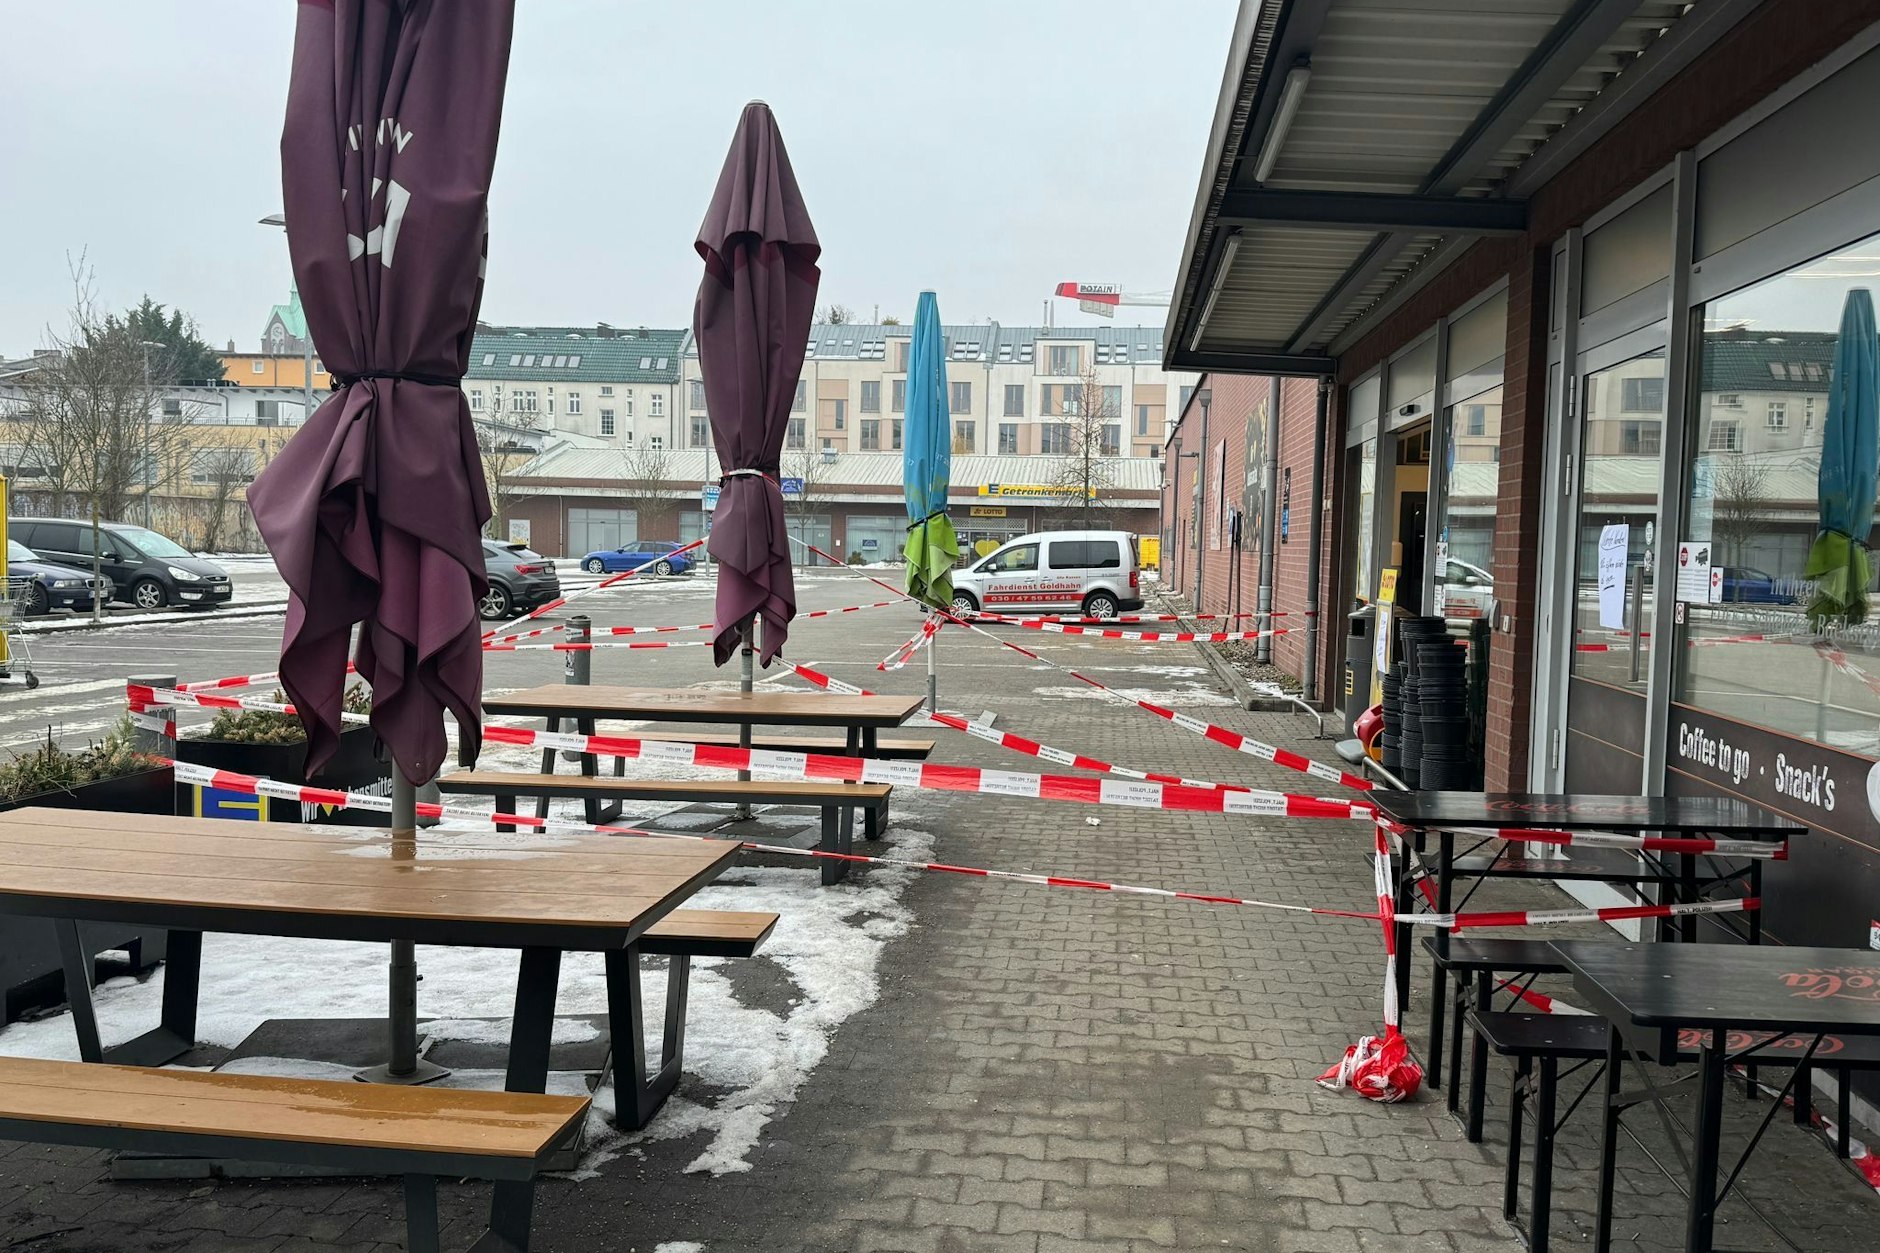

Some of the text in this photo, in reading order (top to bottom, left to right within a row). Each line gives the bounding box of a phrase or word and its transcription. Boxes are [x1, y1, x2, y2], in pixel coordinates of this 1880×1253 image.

[1679, 722, 1836, 812] Coffee to go Snack's
